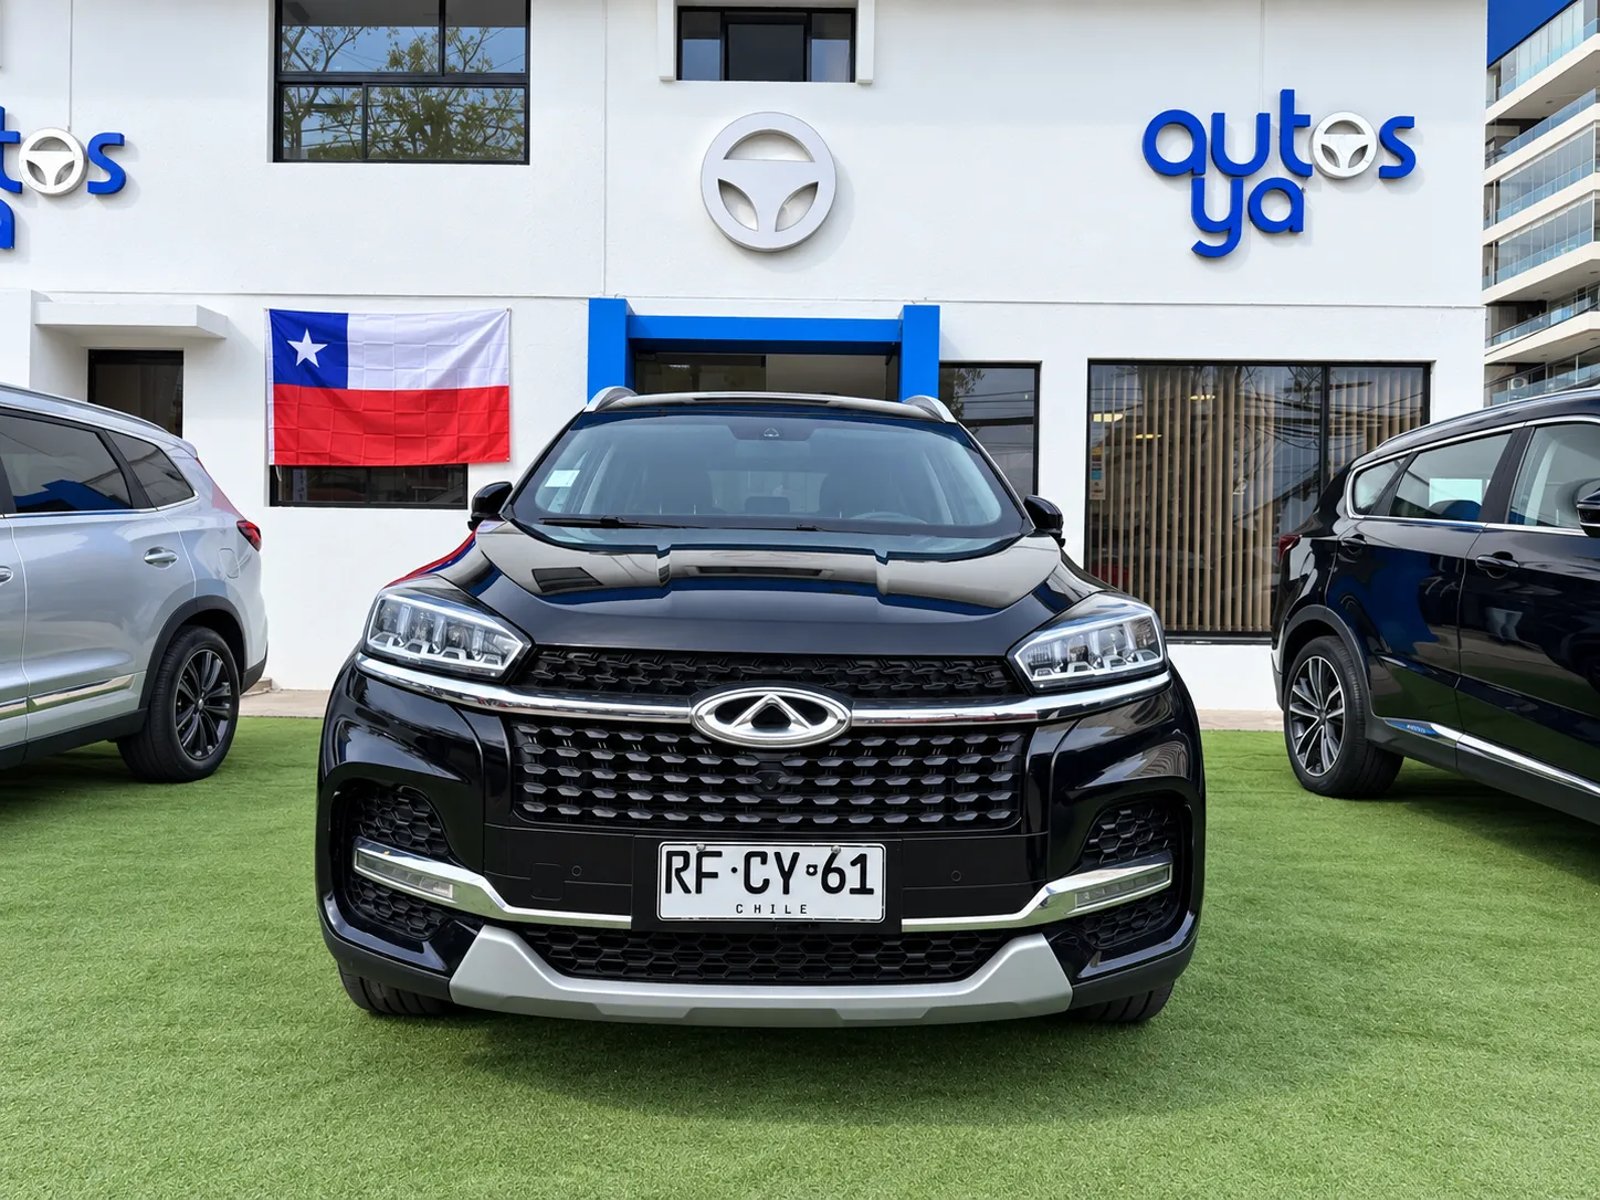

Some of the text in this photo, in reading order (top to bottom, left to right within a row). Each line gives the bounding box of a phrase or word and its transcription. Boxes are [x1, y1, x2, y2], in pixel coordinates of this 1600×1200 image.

[1142, 89, 1416, 180] autos
[1191, 177, 1304, 258] ya
[735, 903, 808, 915] CHILE
